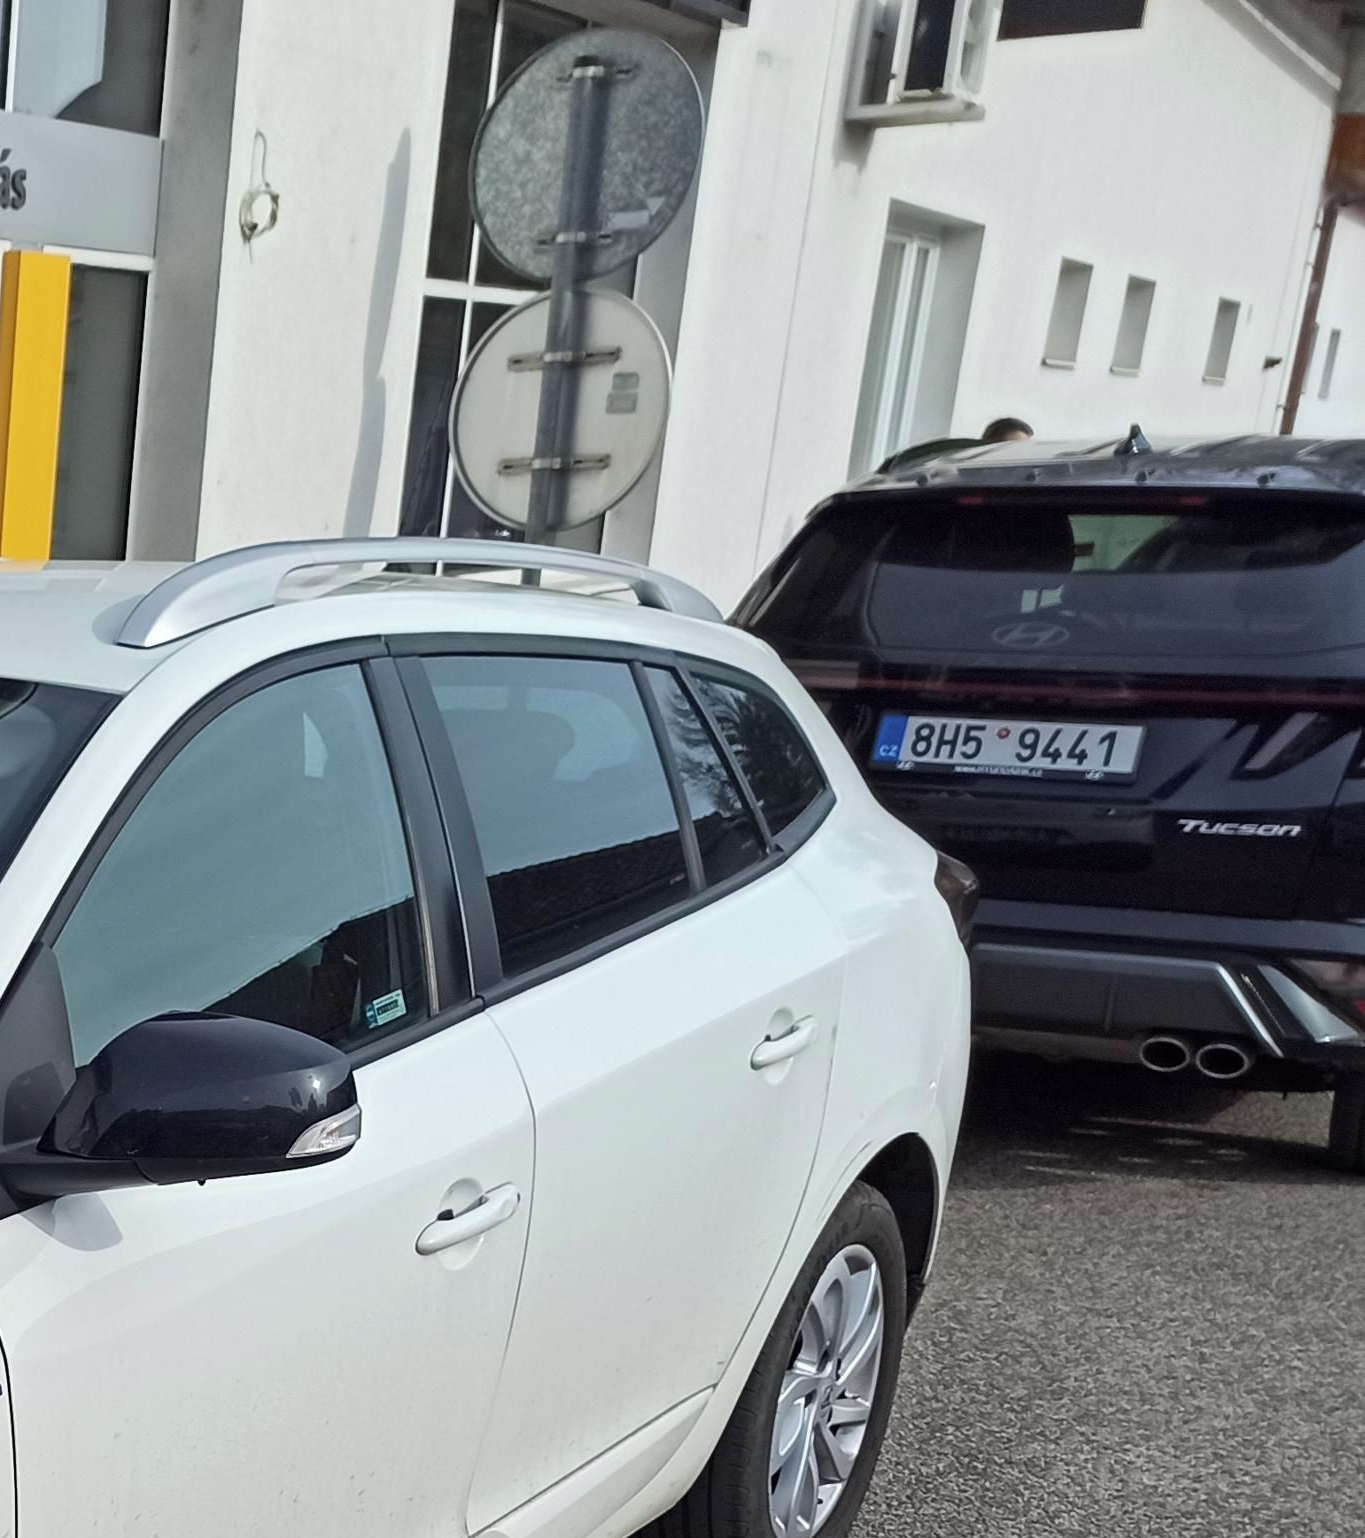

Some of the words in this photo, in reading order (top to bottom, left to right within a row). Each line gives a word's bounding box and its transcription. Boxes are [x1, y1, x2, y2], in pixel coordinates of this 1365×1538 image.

[879, 744, 898, 757] CZ
[910, 722, 987, 761] 8H5
[1014, 727, 1118, 767] 9441
